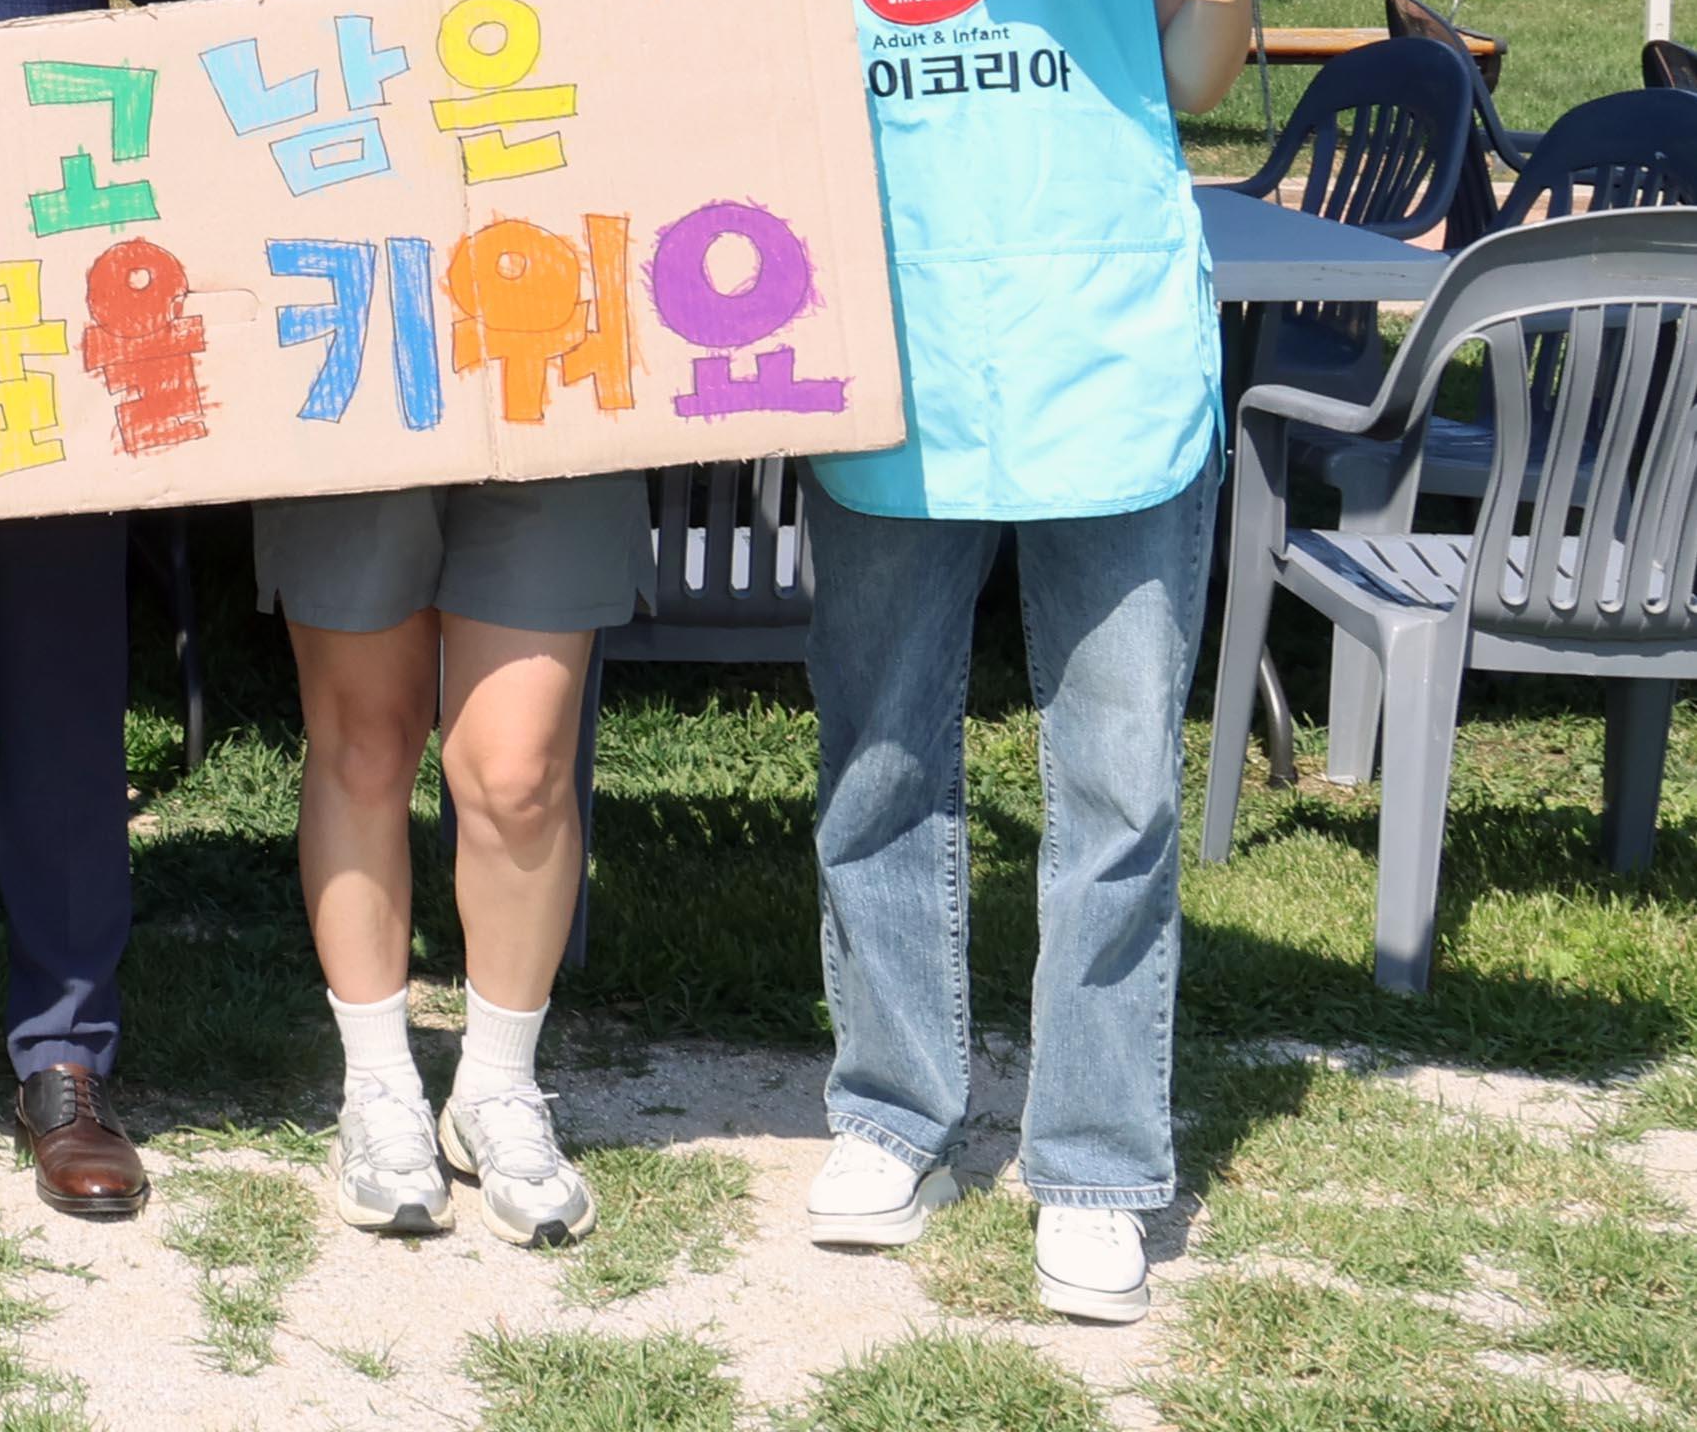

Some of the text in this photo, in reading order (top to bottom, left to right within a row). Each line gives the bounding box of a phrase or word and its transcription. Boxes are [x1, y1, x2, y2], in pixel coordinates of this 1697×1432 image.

[873, 26, 1011, 51] Adult & Infant
[867, 48, 1072, 101] 이코리아
[264, 200, 846, 432] 키워요
